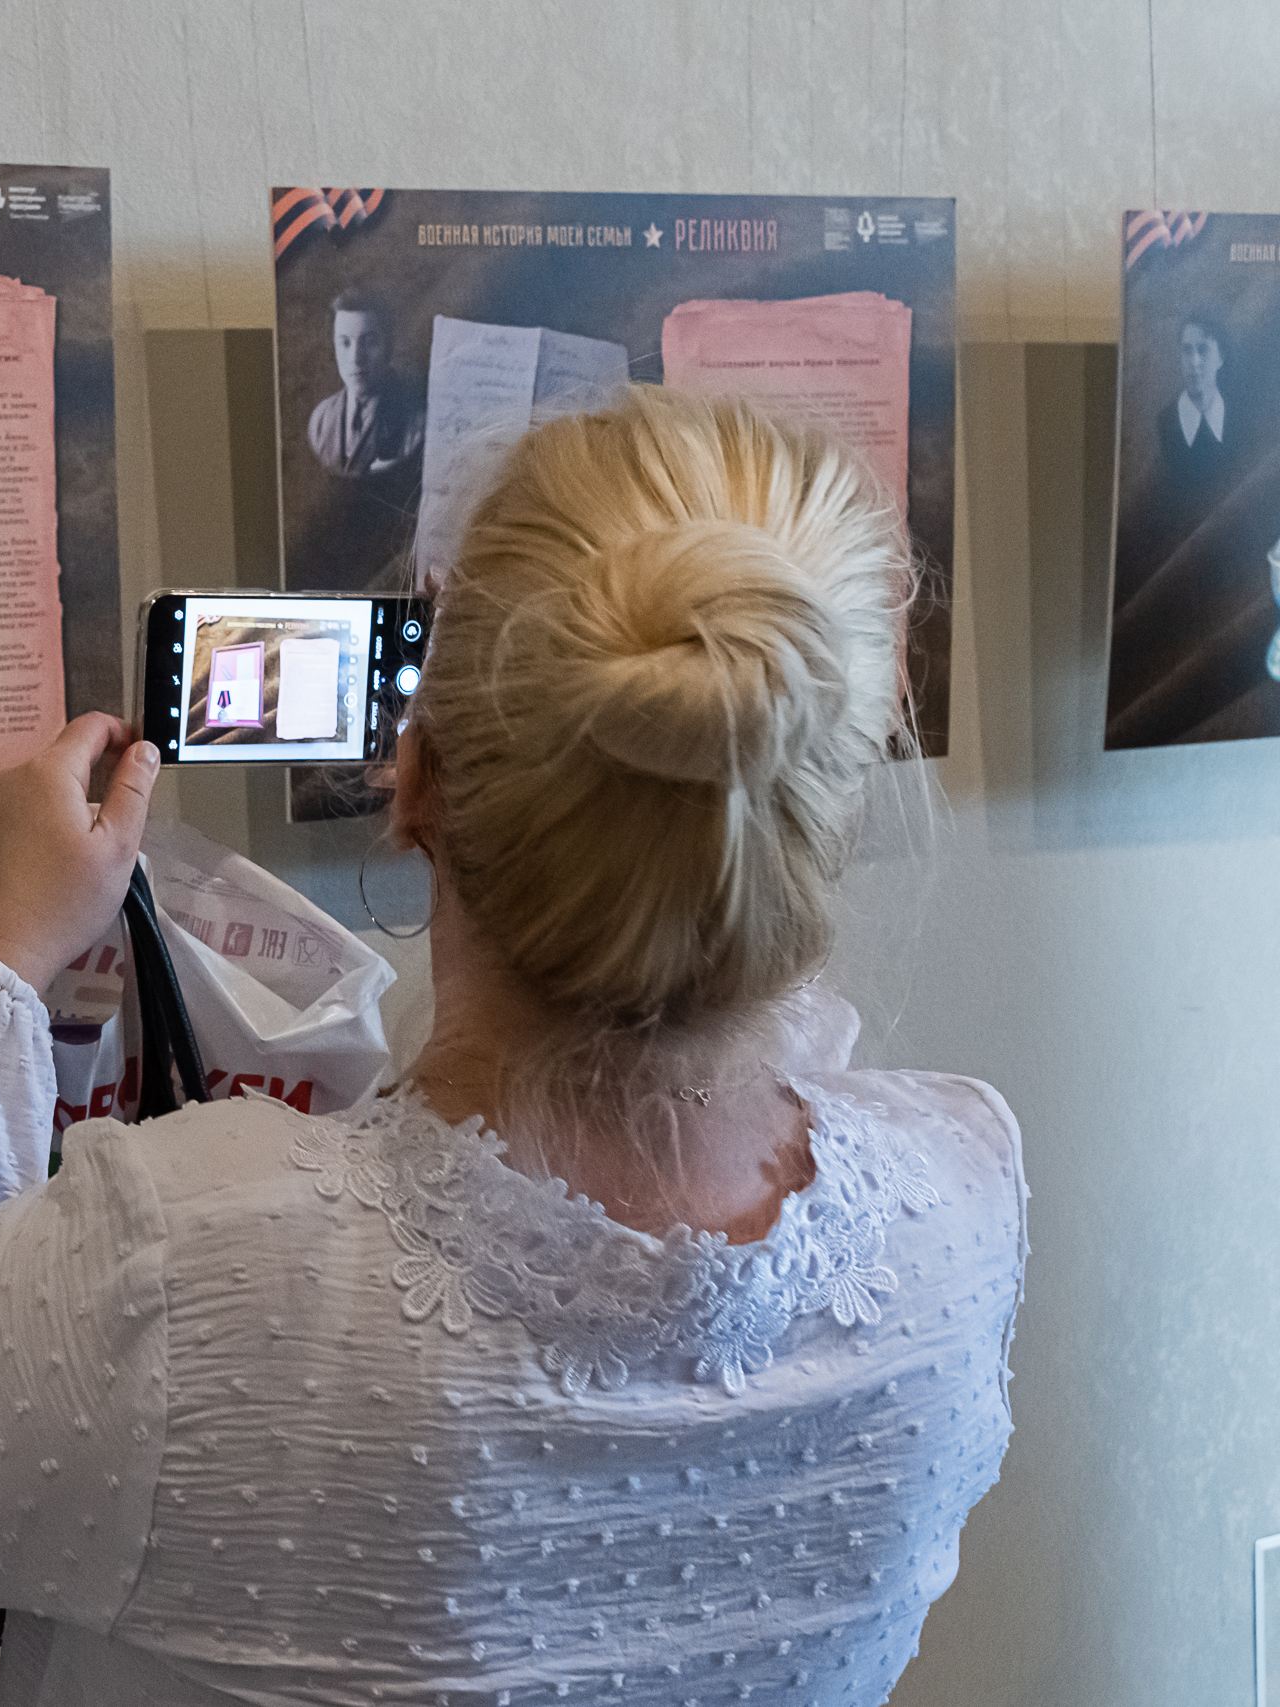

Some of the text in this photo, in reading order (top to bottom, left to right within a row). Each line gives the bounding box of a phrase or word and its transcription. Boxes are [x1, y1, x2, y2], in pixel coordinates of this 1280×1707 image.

[418, 224, 479, 246] ВОЕННАЯ
[483, 225, 542, 246] ИСТОРИЯ
[587, 226, 632, 247] СЕМЬИ
[675, 219, 778, 251] РЕЛИКВИЯ
